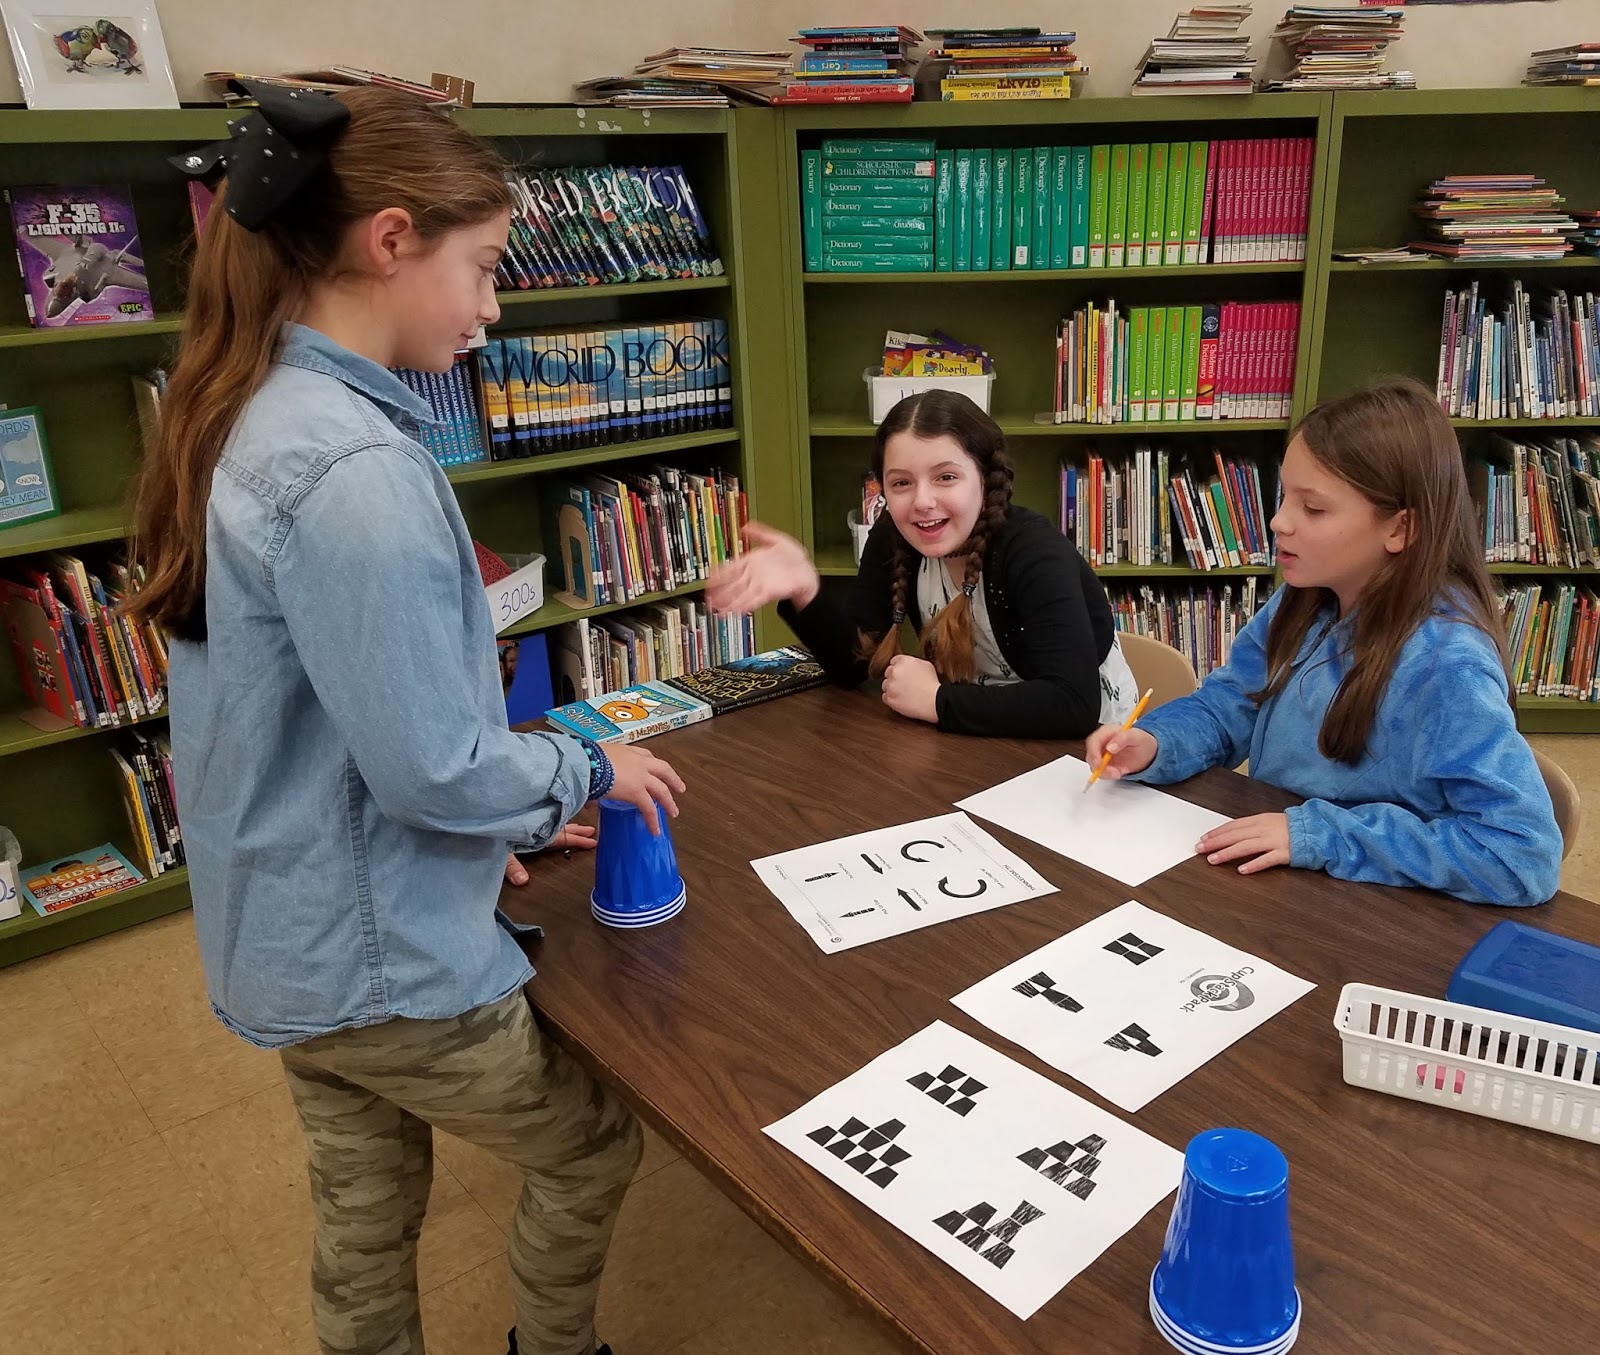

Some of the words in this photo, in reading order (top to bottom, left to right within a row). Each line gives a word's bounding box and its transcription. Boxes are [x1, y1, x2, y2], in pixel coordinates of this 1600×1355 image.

[997, 78, 1041, 89] GIANT
[829, 146, 862, 154] Dictionary
[1018, 158, 1026, 193] Dictionary
[1057, 156, 1065, 191] Dictionary
[1076, 155, 1085, 190] Dictionary
[506, 176, 583, 219] ORLD
[830, 183, 861, 192] Dictionary
[47, 203, 100, 224] F-35
[829, 201, 861, 211] Dictionary
[28, 222, 107, 236] LIGHTNING
[831, 240, 862, 248] Dictionary
[832, 259, 863, 267] Dictionary
[121, 303, 142, 313] EPIC
[484, 339, 616, 392] WORLD
[623, 332, 730, 378] BOOK
[1200, 344, 1209, 380] Dictionary
[1208, 344, 1217, 378] Children's
[456, 366, 464, 390] WORLD
[460, 390, 470, 421] ALMANAC
[464, 364, 472, 391] WORLD
[468, 388, 477, 419] ALMANAC
[442, 393, 452, 424] ALMANAC
[452, 394, 462, 423] ALMANAC
[0, 420, 30, 436] ORDS
[18, 476, 37, 484] SNOW
[0, 496, 17, 506] HEY
[19, 489, 47, 502] MEAN
[500, 582, 536, 622] 300s
[50, 865, 96, 884] KIDS
[61, 873, 96, 888] GET
[45, 874, 126, 902] CODING
[1230, 966, 1255, 981] Cup
[1209, 977, 1237, 997] Stack
[1179, 990, 1212, 1013] Pack
